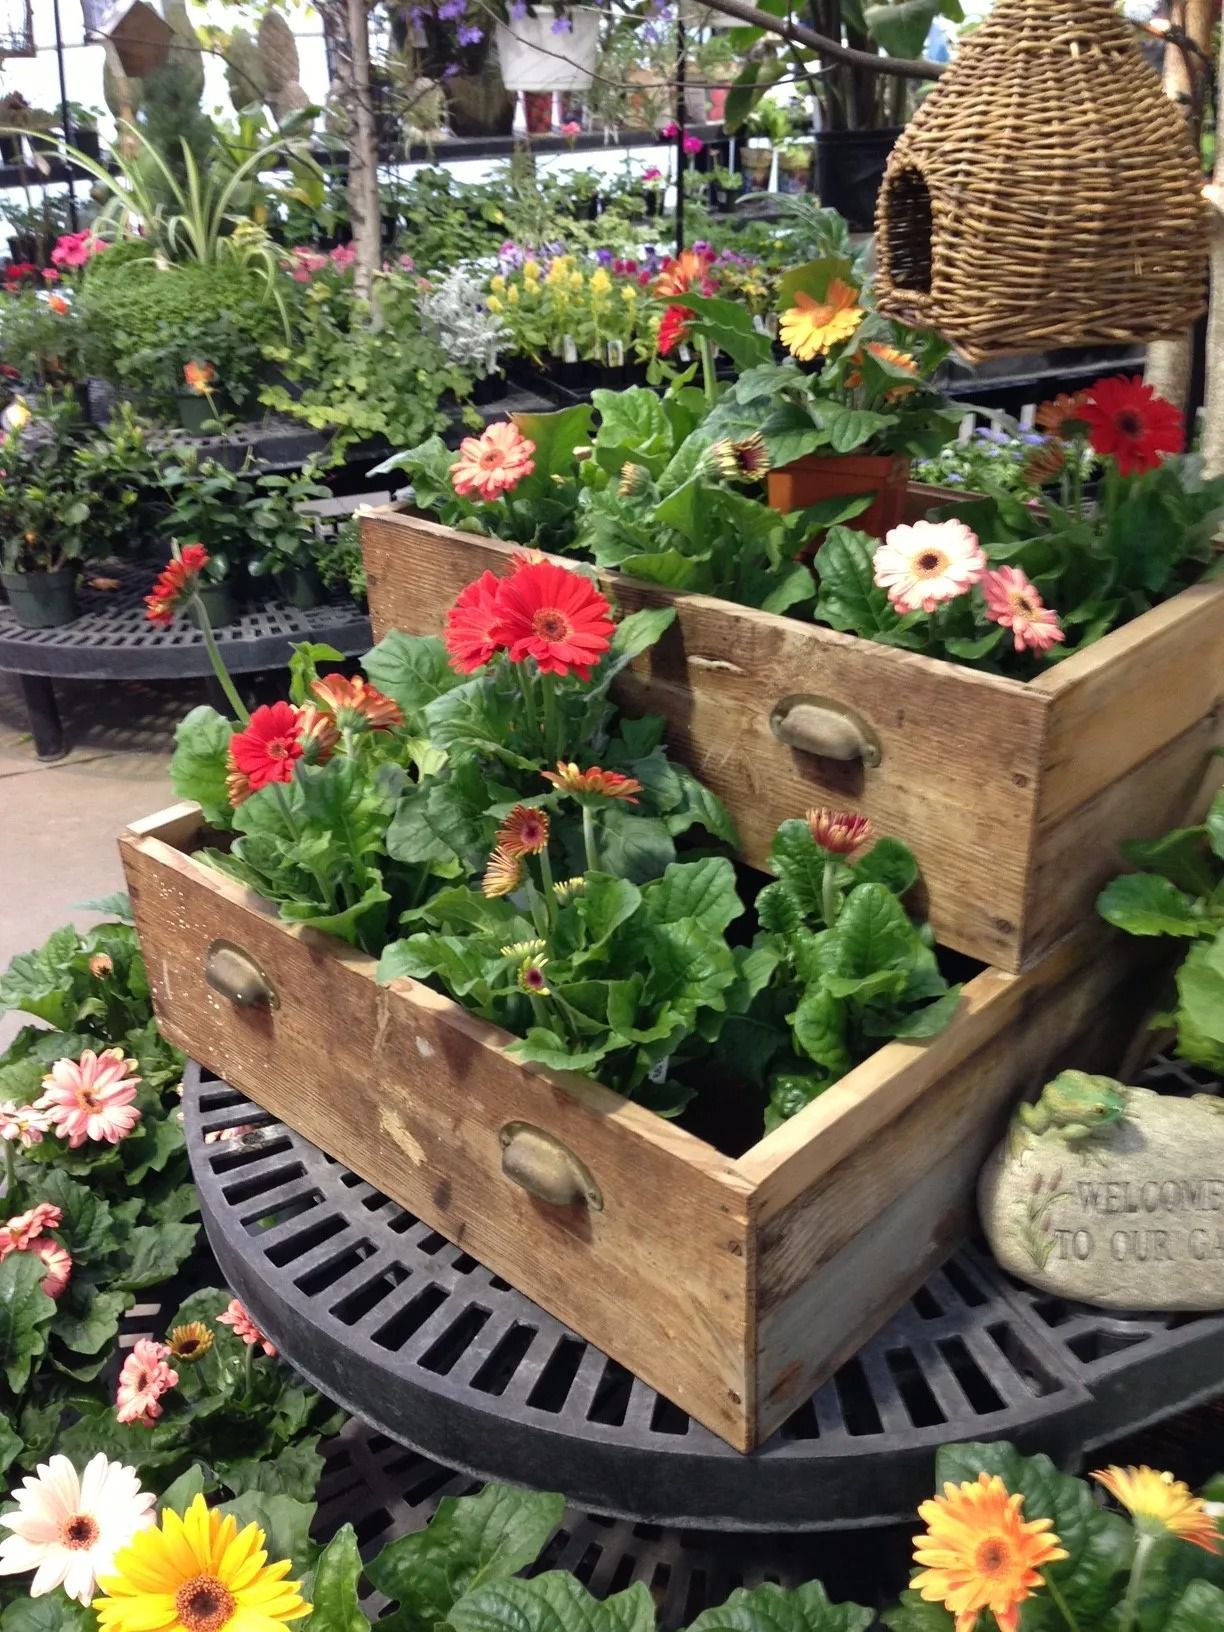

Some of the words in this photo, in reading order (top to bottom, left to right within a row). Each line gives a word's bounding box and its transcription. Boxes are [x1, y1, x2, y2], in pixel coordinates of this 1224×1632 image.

[1076, 1179, 1224, 1213] WELCOME
[1054, 1229, 1094, 1260] TO
[1110, 1229, 1176, 1261] OUR
